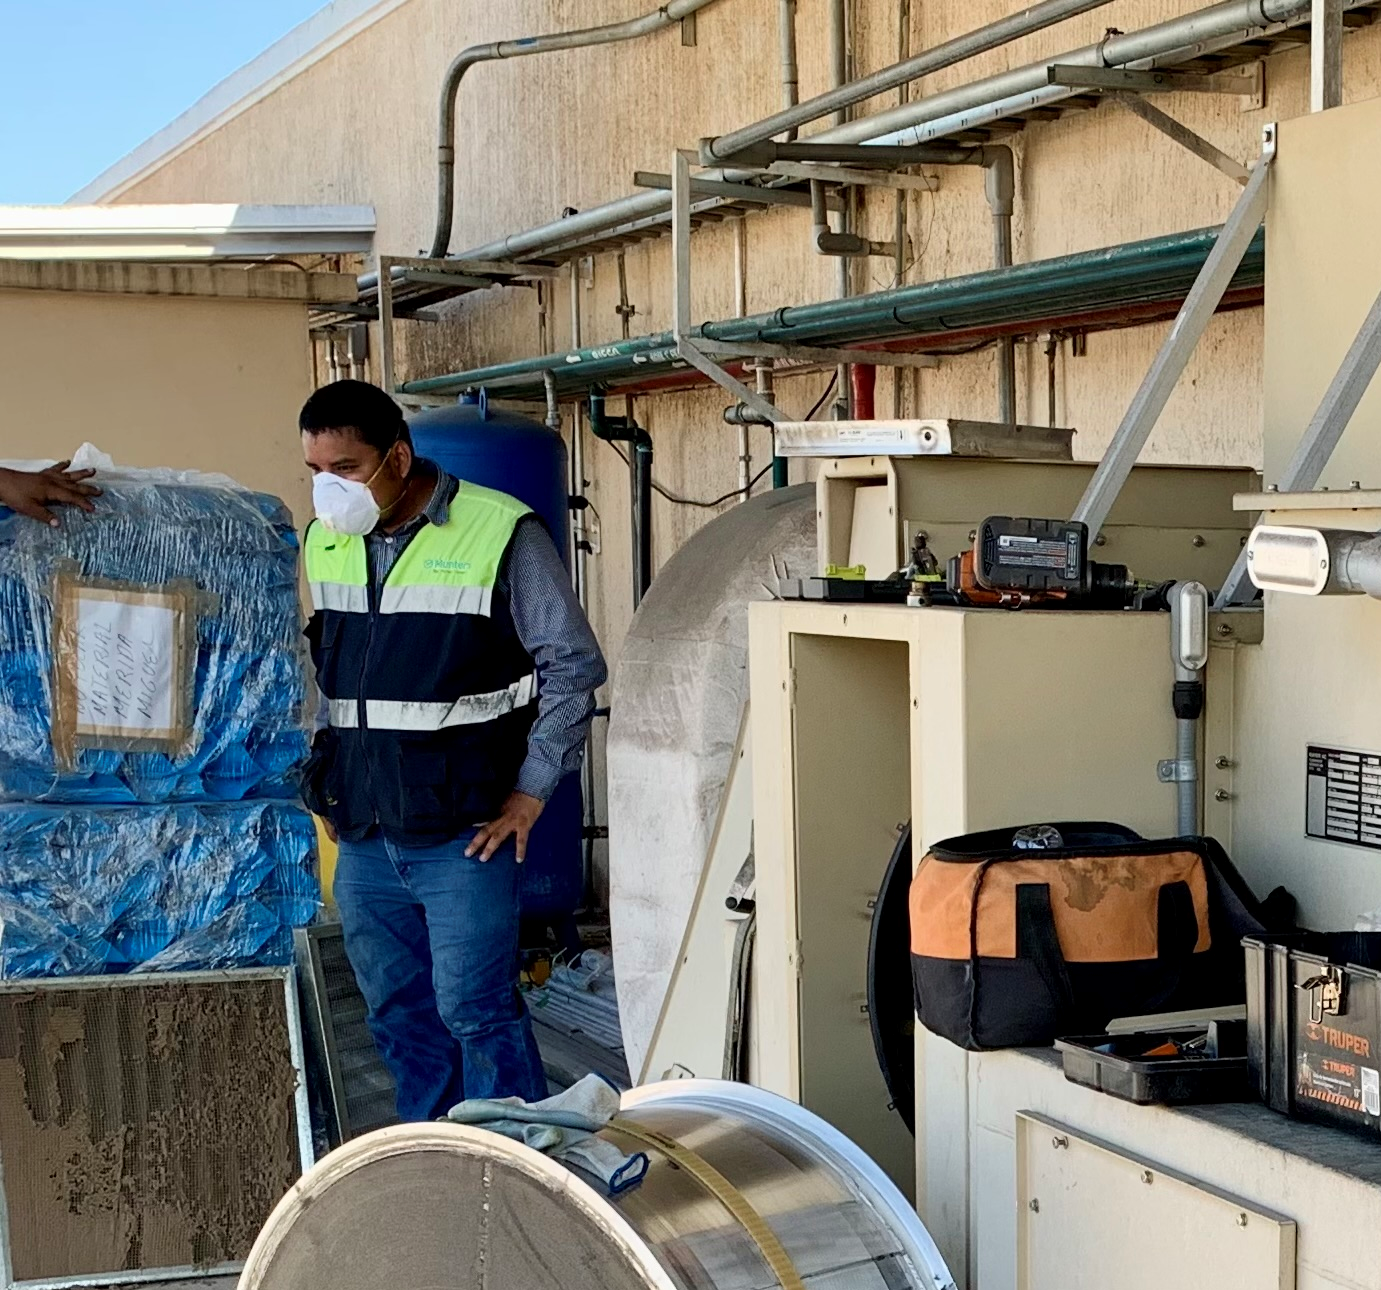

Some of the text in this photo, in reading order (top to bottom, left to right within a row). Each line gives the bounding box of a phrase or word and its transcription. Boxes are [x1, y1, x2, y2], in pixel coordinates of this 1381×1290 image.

[91, 622, 112, 716] MATERIAL
[112, 633, 134, 719] MERIDA
[136, 624, 158, 719] MIGUEL
[1321, 1025, 1370, 1058] TRUPER
[1330, 1061, 1356, 1077] TRUPER
